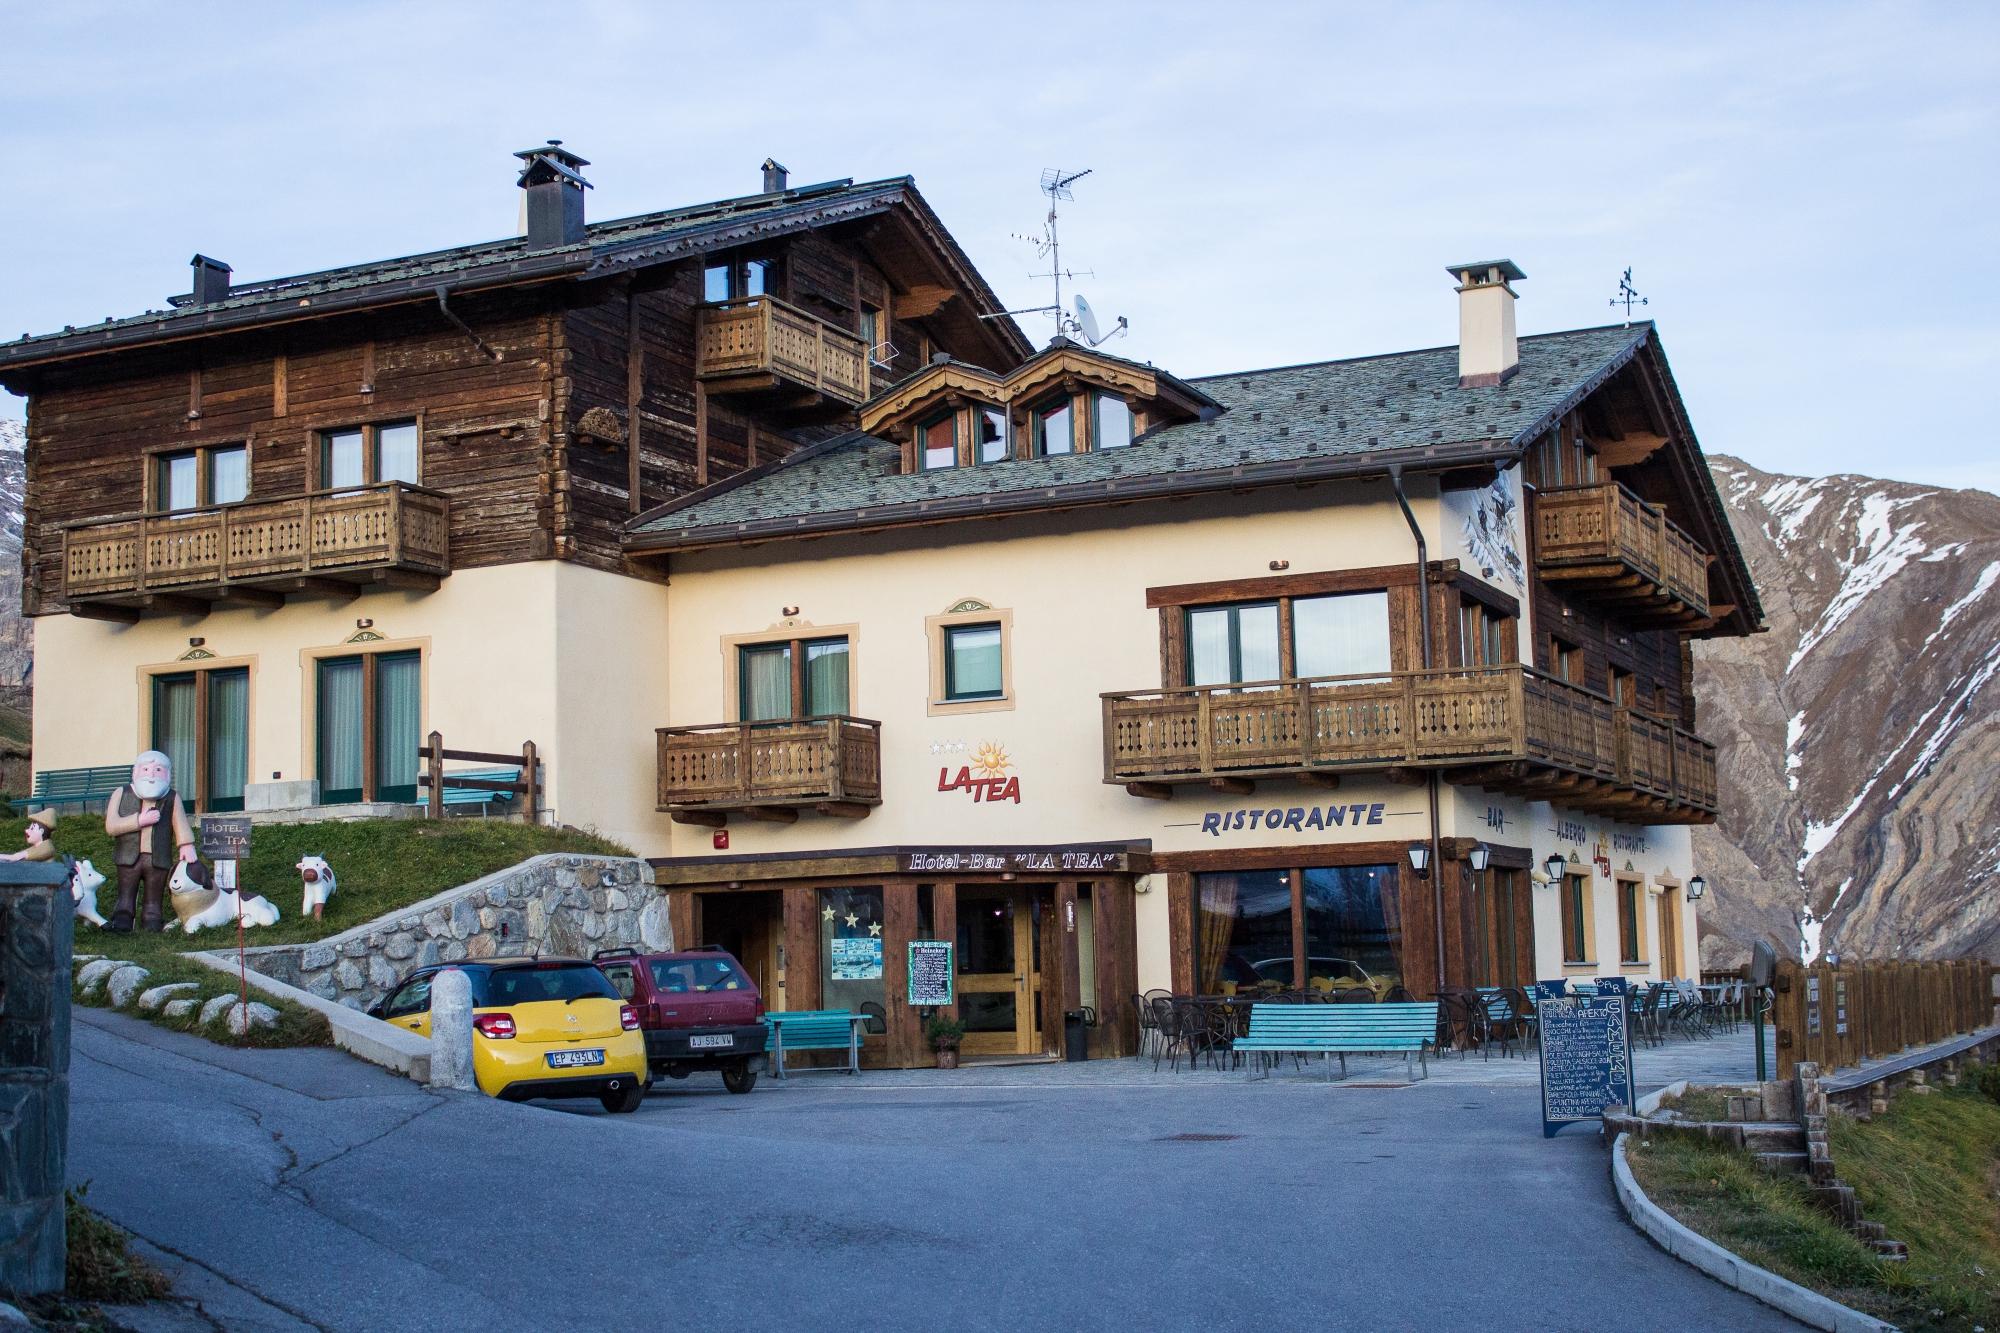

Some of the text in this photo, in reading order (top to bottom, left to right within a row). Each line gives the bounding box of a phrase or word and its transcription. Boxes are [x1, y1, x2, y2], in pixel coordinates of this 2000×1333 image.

[937, 765, 1021, 804] LA TEA
[205, 824, 243, 833] HOTEL
[1201, 803, 1386, 836] RISTORANTE
[1487, 806, 1504, 834] BAR
[1556, 819, 1586, 846] ALBERGO
[1613, 833, 1646, 855] RISTORANTE
[909, 853, 1006, 870] Hotel-Bar
[1595, 978, 1621, 994] BAR
[1577, 1008, 1608, 1018] APERTO
[1606, 1000, 1626, 1085] CAMERE
[555, 1053, 566, 1064] EP
[1550, 1105, 1585, 1113] COLAZIONI
